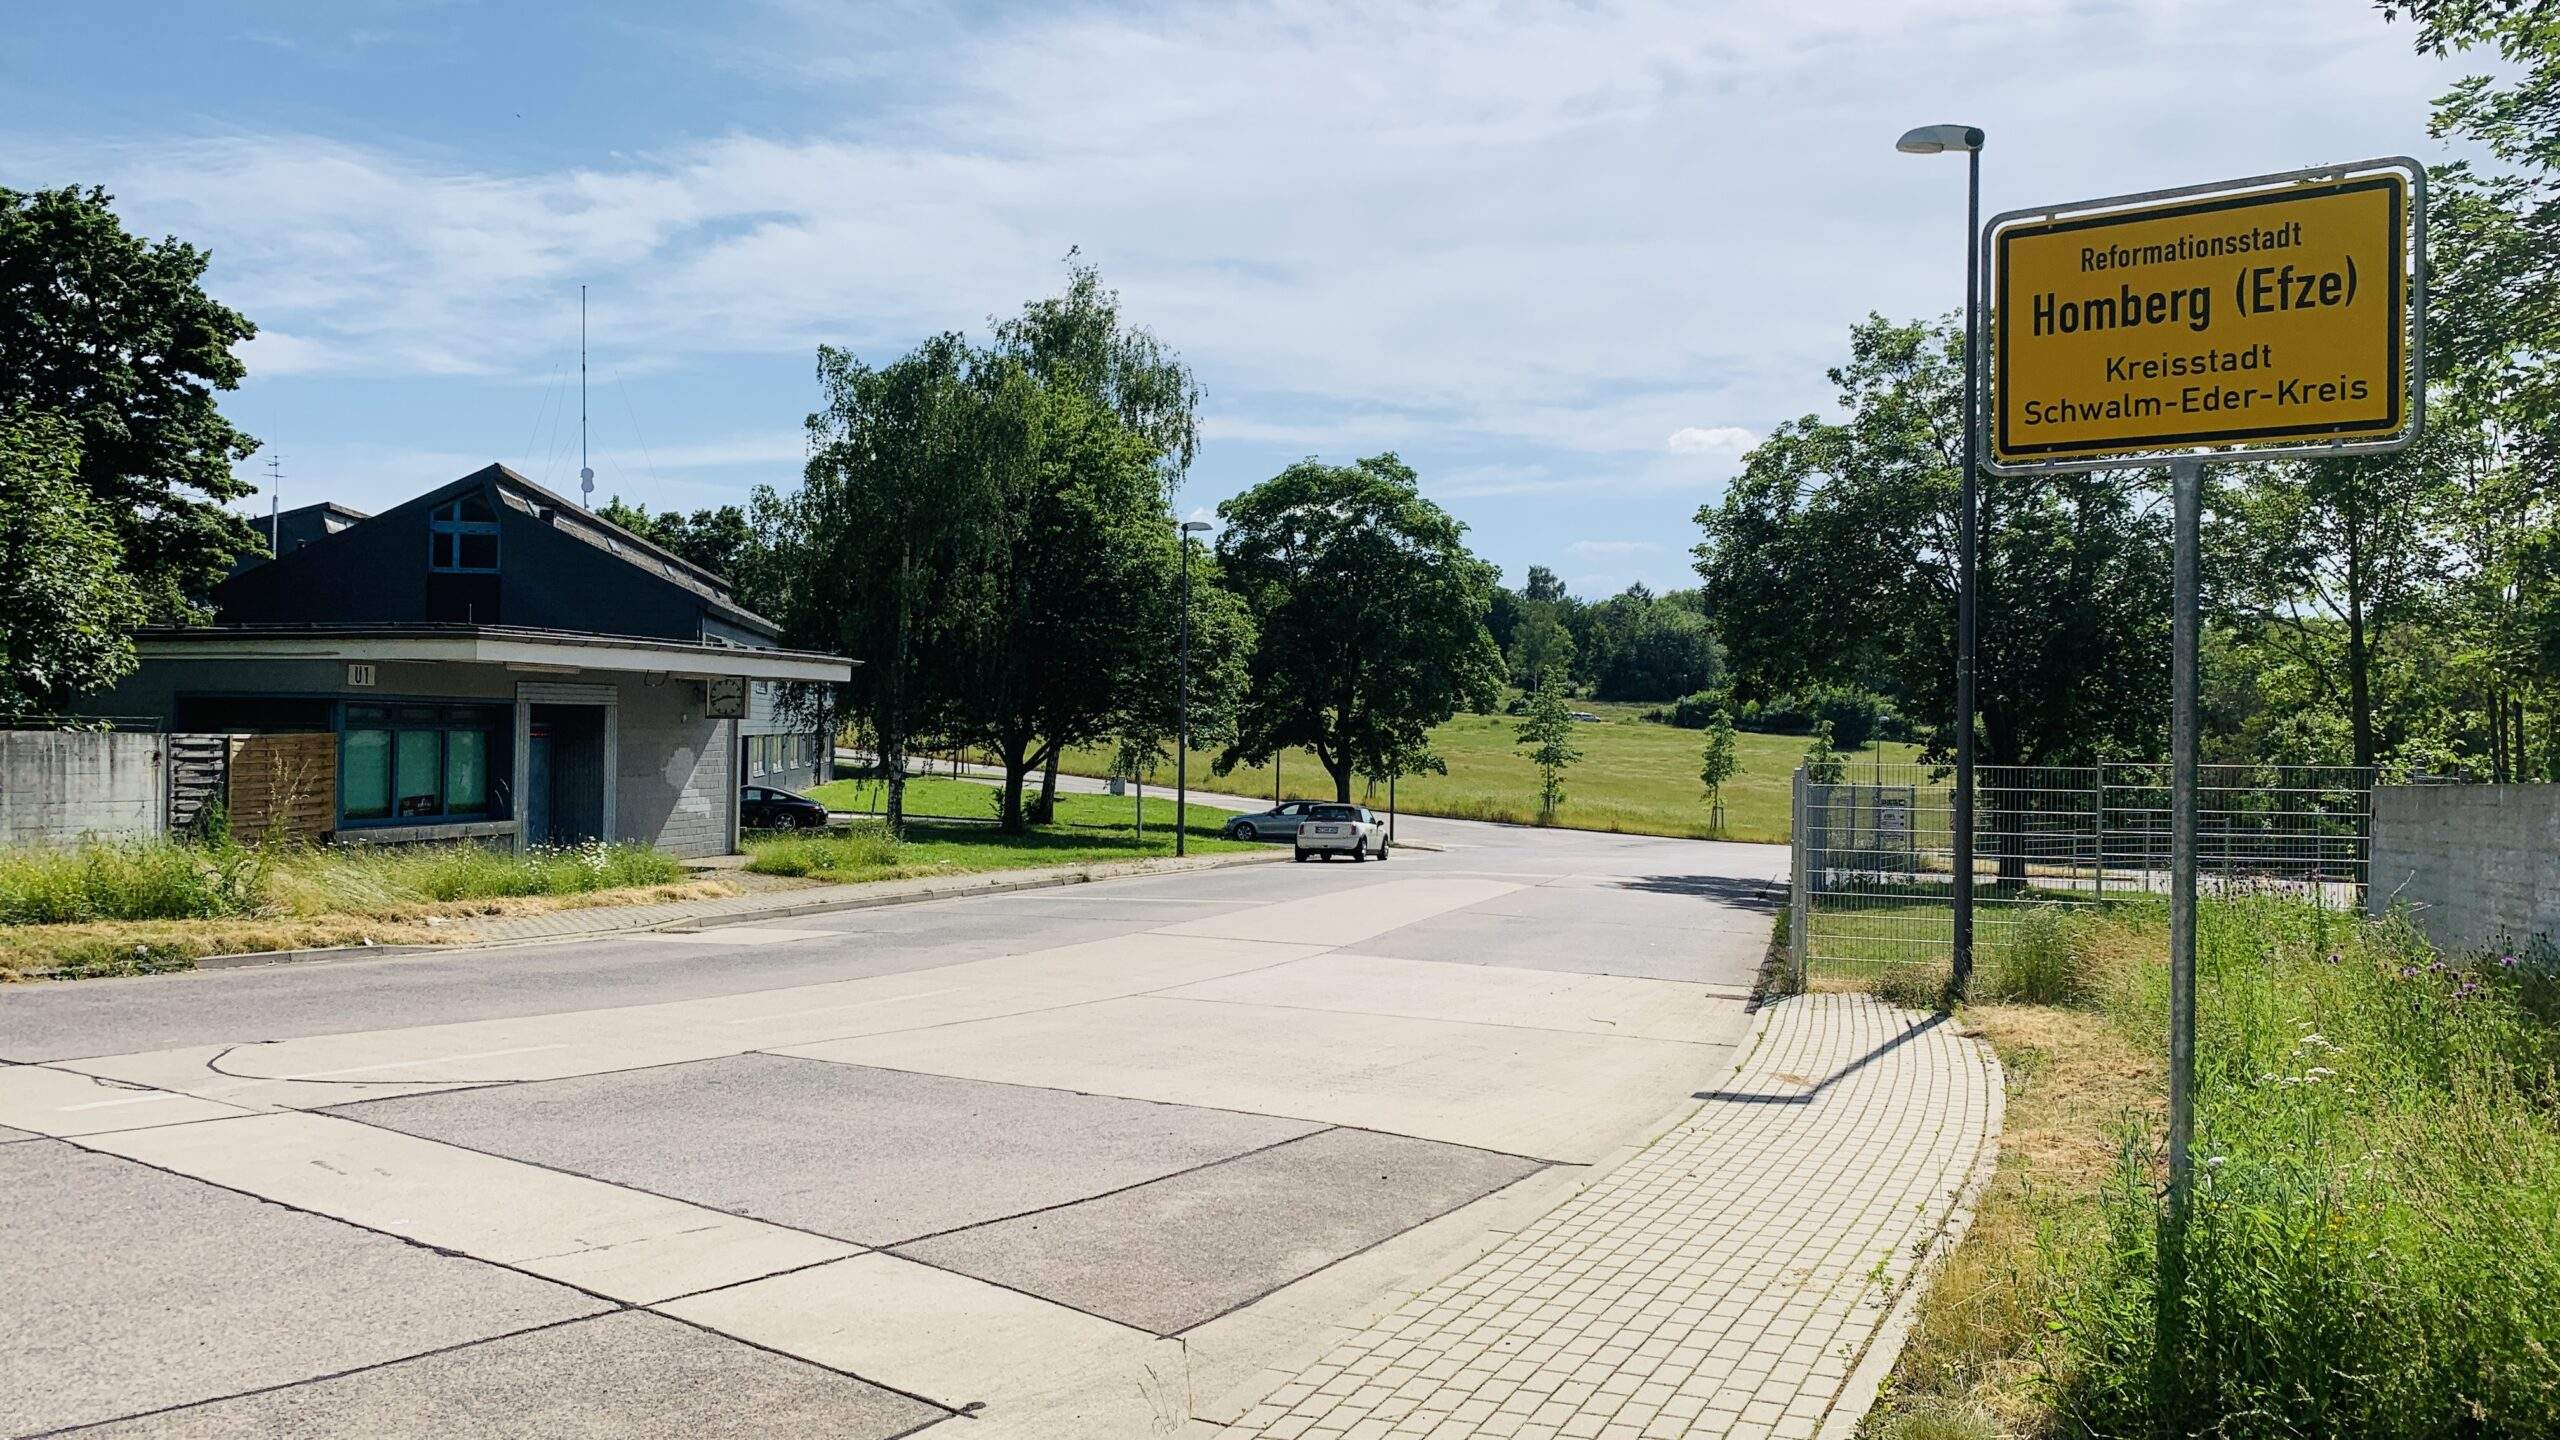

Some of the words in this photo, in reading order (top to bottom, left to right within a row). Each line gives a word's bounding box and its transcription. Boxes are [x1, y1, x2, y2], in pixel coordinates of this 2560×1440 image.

[2080, 221, 2302, 273] Reformationsstadt
[2032, 283, 2211, 337] Homberg
[2235, 254, 2358, 318] (Efze)
[2105, 343, 2273, 383] Kreisstadt
[2023, 374, 2369, 426] Schwalm-Eder-Kreis
[354, 665, 369, 684] U1
